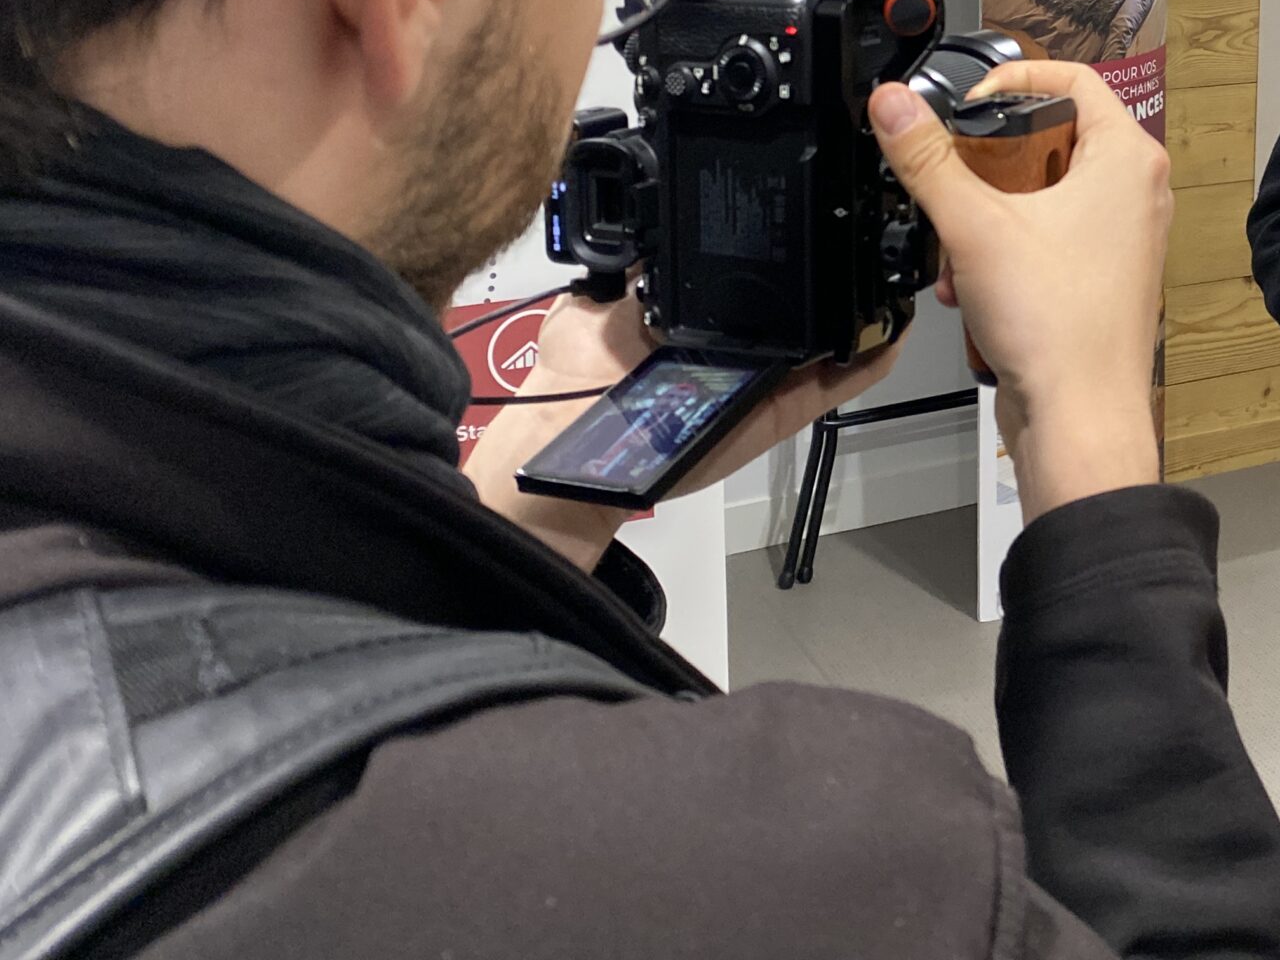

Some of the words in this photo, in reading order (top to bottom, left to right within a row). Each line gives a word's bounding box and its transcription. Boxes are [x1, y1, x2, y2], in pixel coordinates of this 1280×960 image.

[1103, 66, 1138, 83] POUR
[1140, 59, 1157, 76] VOS
[1113, 76, 1159, 100] OCHAINES
[1126, 90, 1164, 121] ANCES
[456, 425, 487, 442] Sta
